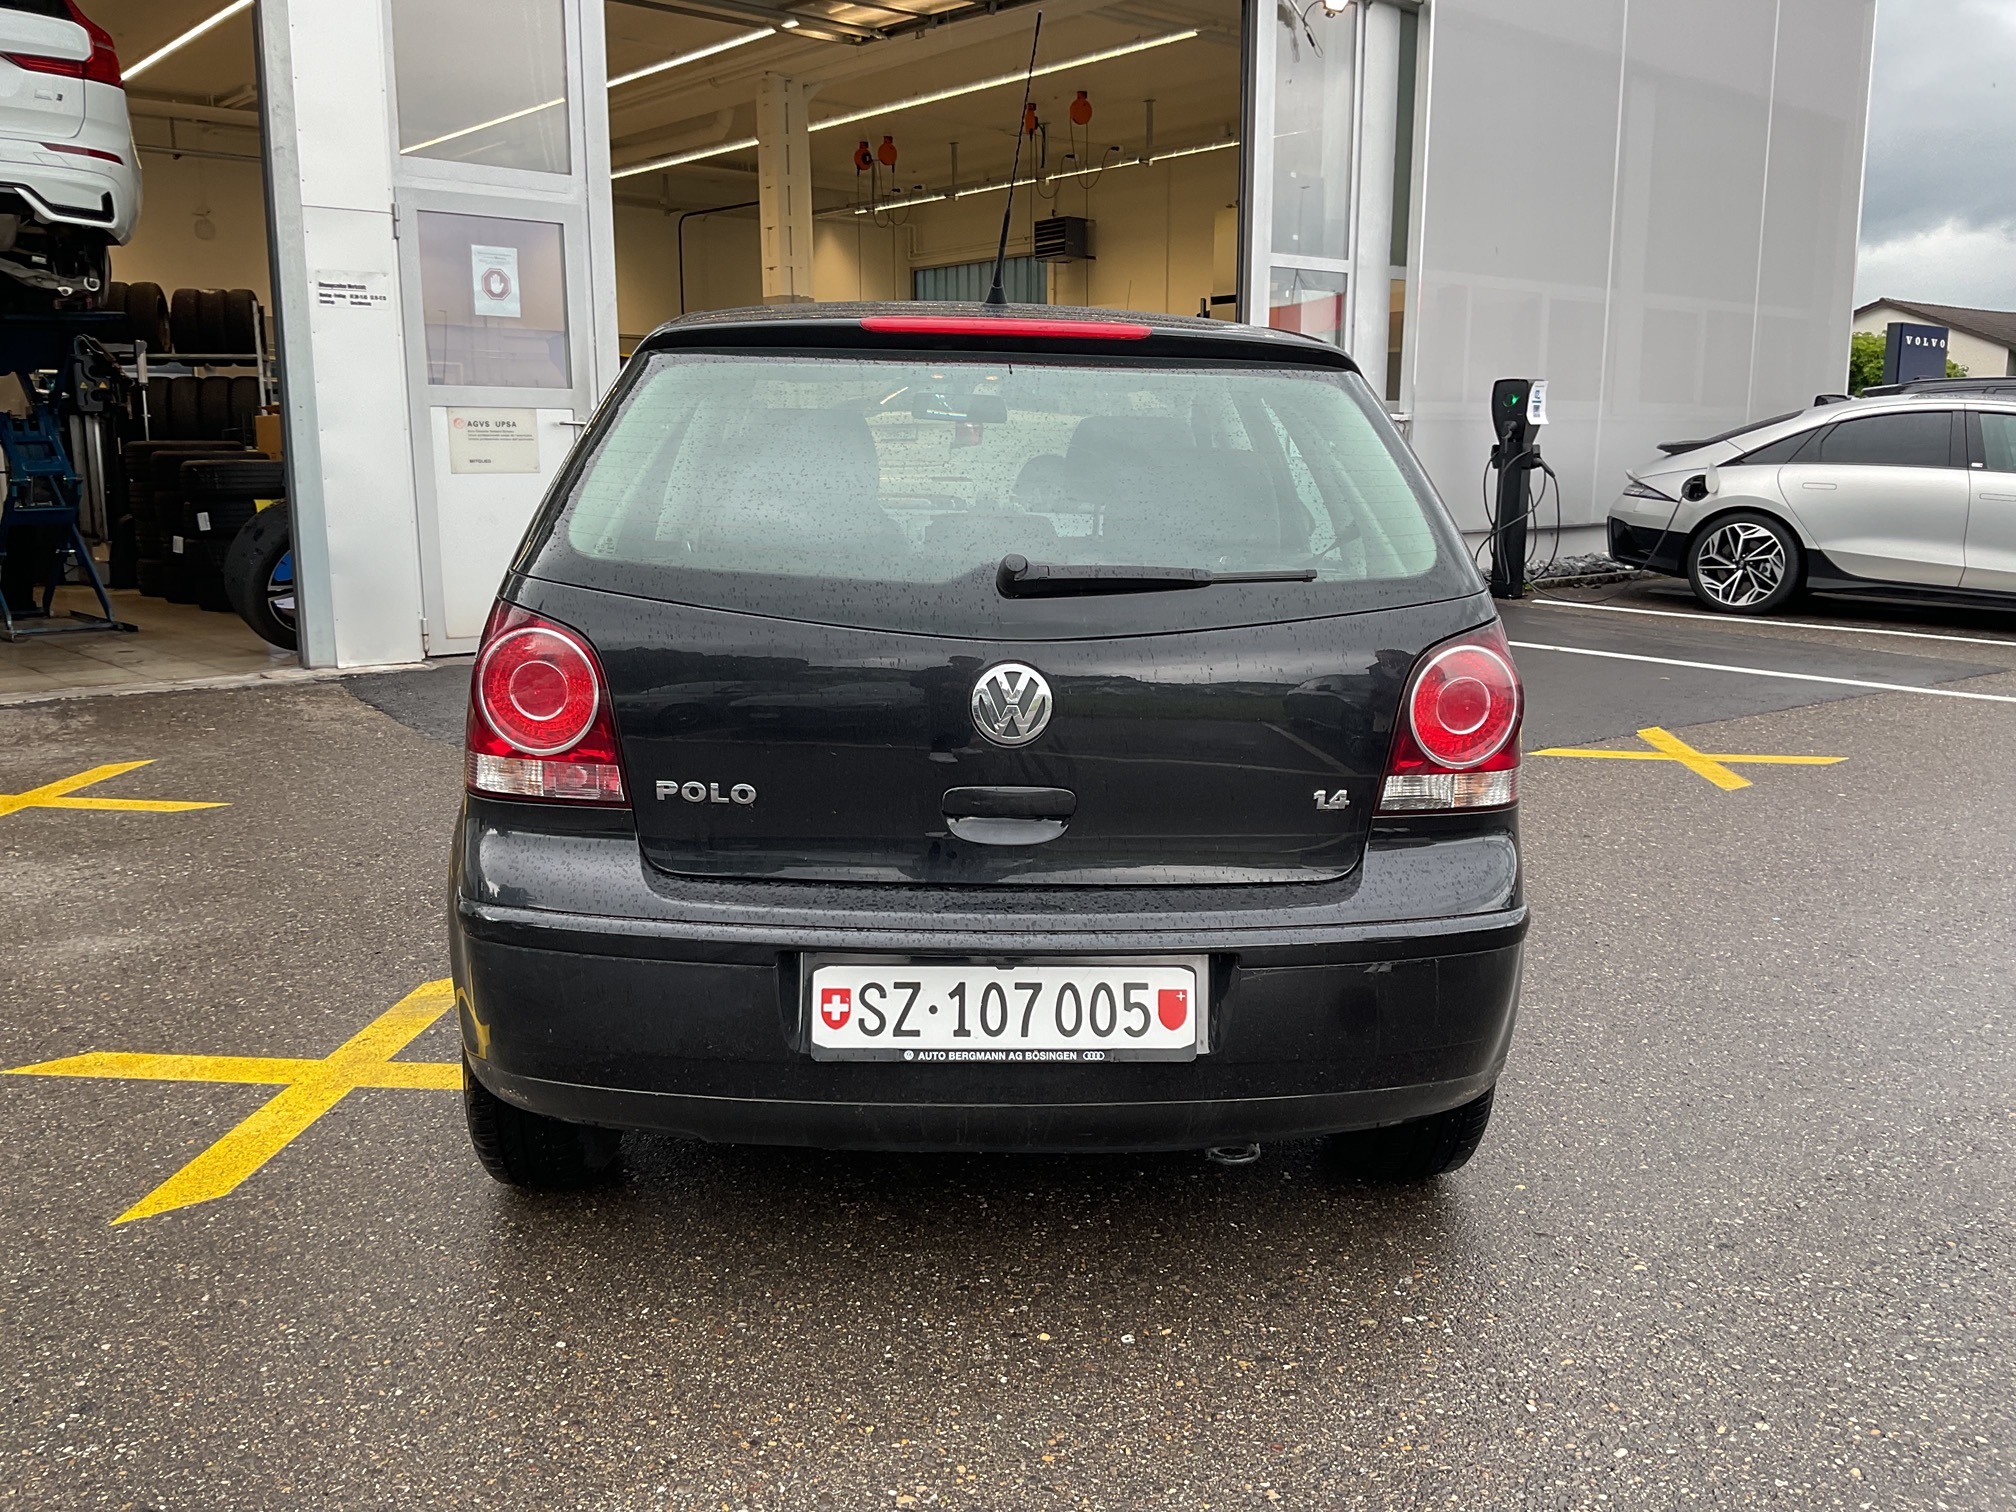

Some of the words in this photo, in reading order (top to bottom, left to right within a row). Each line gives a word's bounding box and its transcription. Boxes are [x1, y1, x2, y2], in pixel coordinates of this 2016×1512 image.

[1906, 335, 1946, 348] VOLVO
[467, 420, 490, 428] AGVS
[656, 780, 757, 805] POLO
[917, 1051, 946, 1061] AUTO
[948, 1051, 1006, 1061] BERGMANN
[1008, 1051, 1023, 1061] AG
[1025, 1049, 1077, 1061] BÖSINGEN
